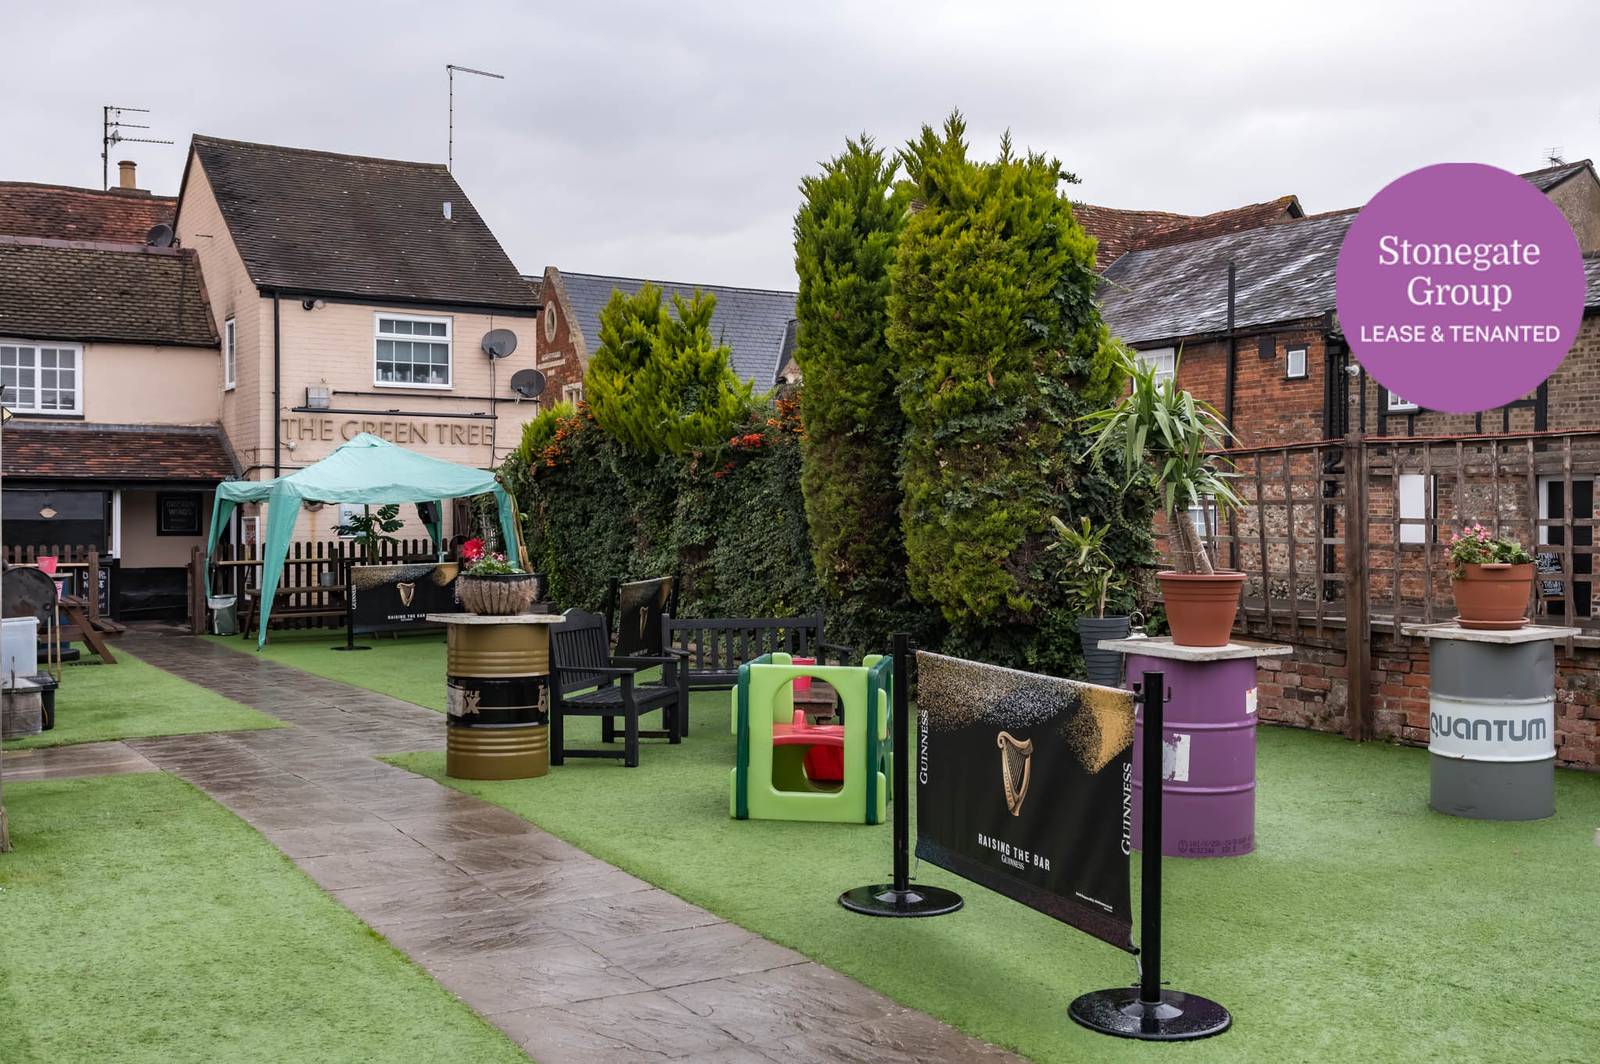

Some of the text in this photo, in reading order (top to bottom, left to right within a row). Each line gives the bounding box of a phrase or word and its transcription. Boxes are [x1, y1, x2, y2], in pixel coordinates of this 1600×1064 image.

[281, 418, 494, 446] THE GREEN TREE
[1430, 712, 1547, 742] QUANTUM
[919, 709, 929, 785] GUINNESS
[1121, 762, 1133, 856] GUINNESS
[978, 832, 1050, 872] RAISING THE BAR
[1001, 853, 1025, 871] GUINNESS
